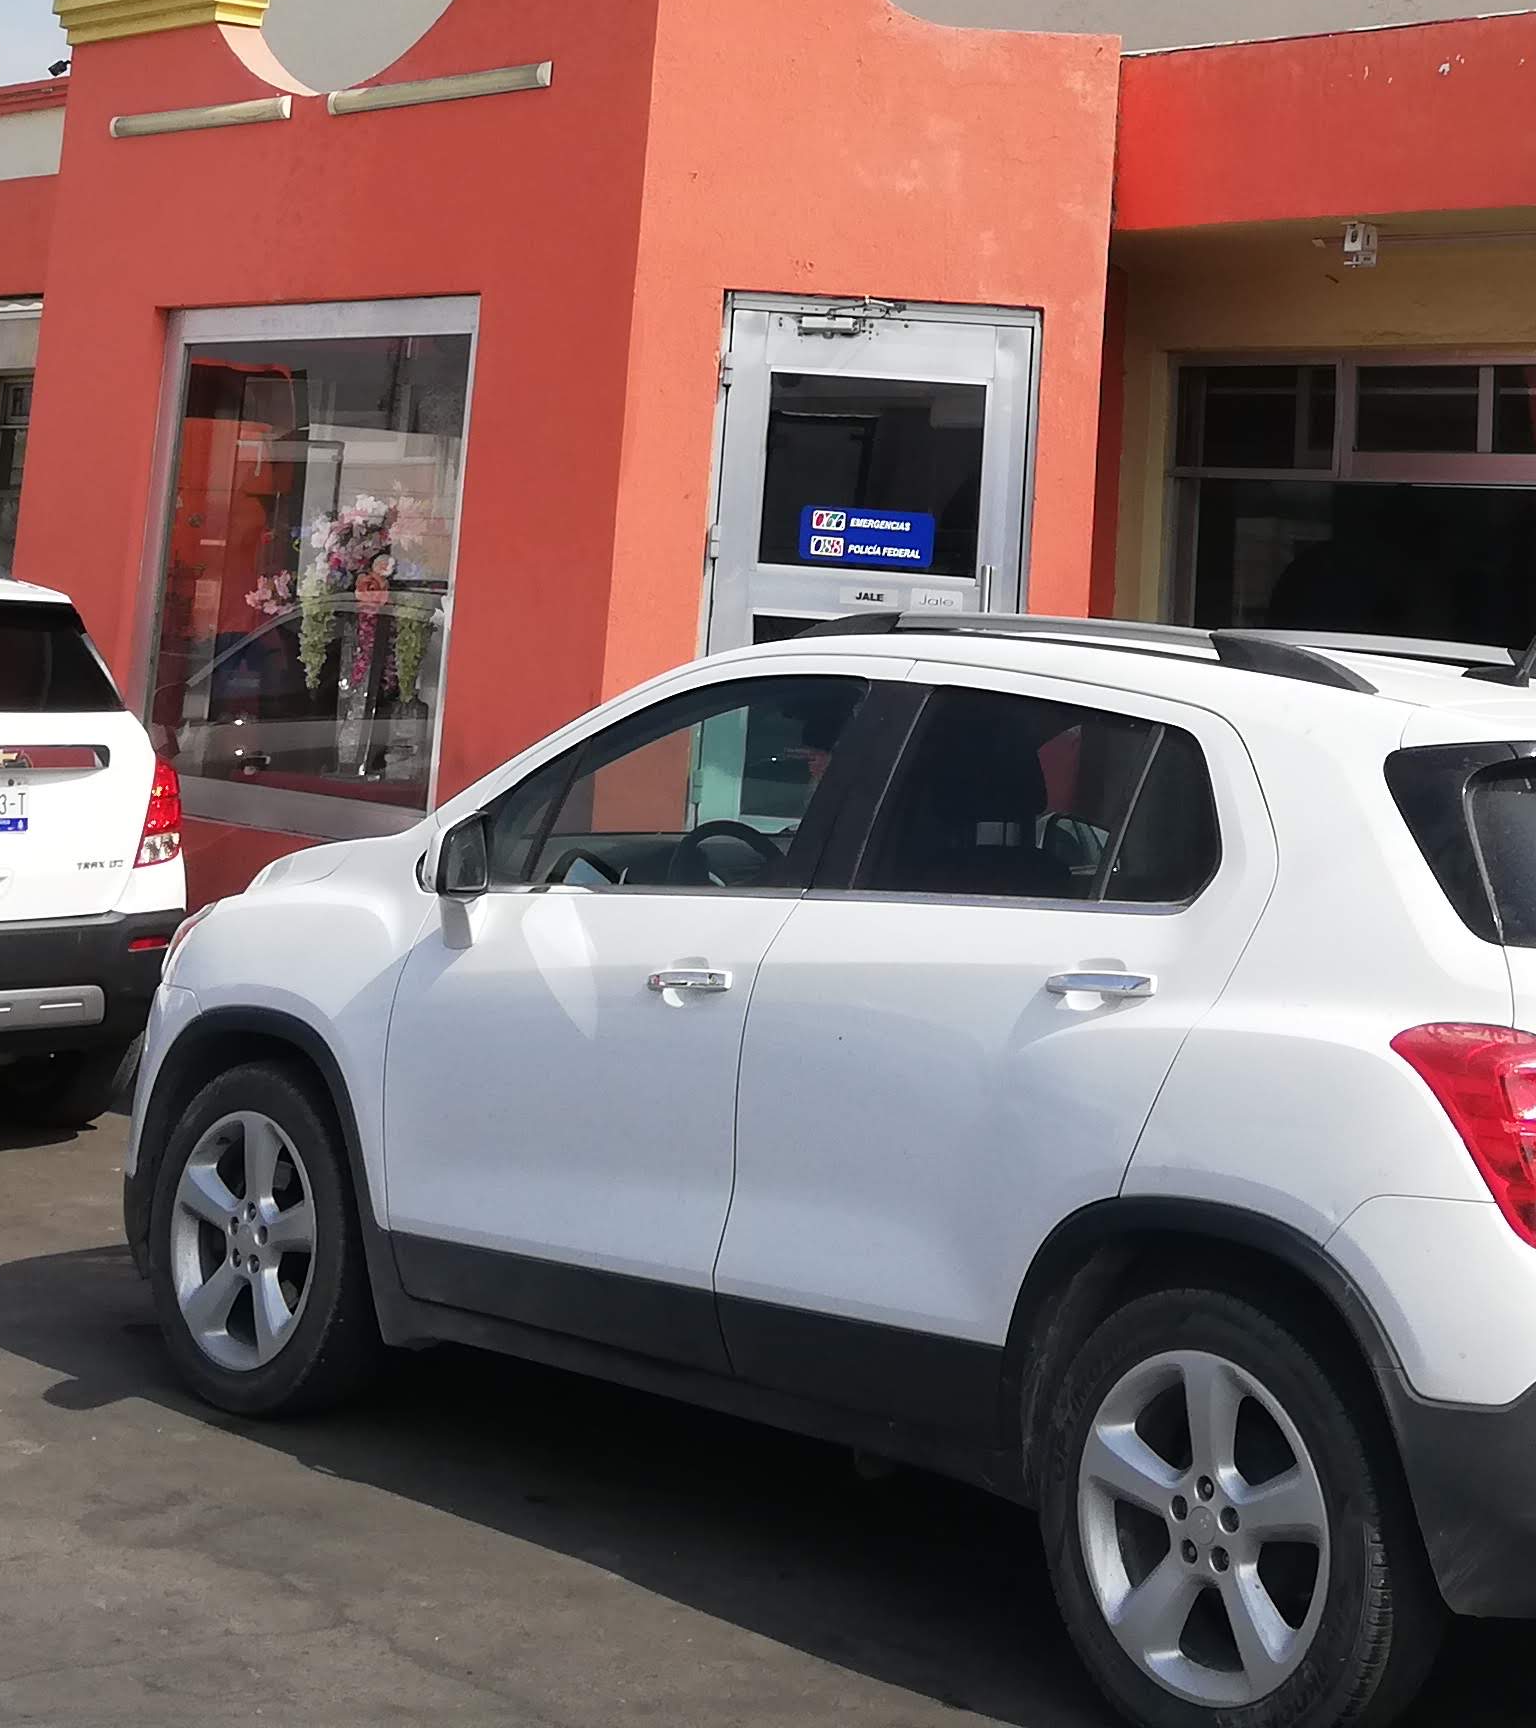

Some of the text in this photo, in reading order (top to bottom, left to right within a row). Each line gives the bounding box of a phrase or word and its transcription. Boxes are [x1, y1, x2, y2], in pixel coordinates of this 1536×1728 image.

[849, 517, 911, 532] EMERGENCIAS
[882, 547, 921, 560] FEDERAL
[855, 591, 885, 603] JALE
[918, 594, 954, 608] Jale
